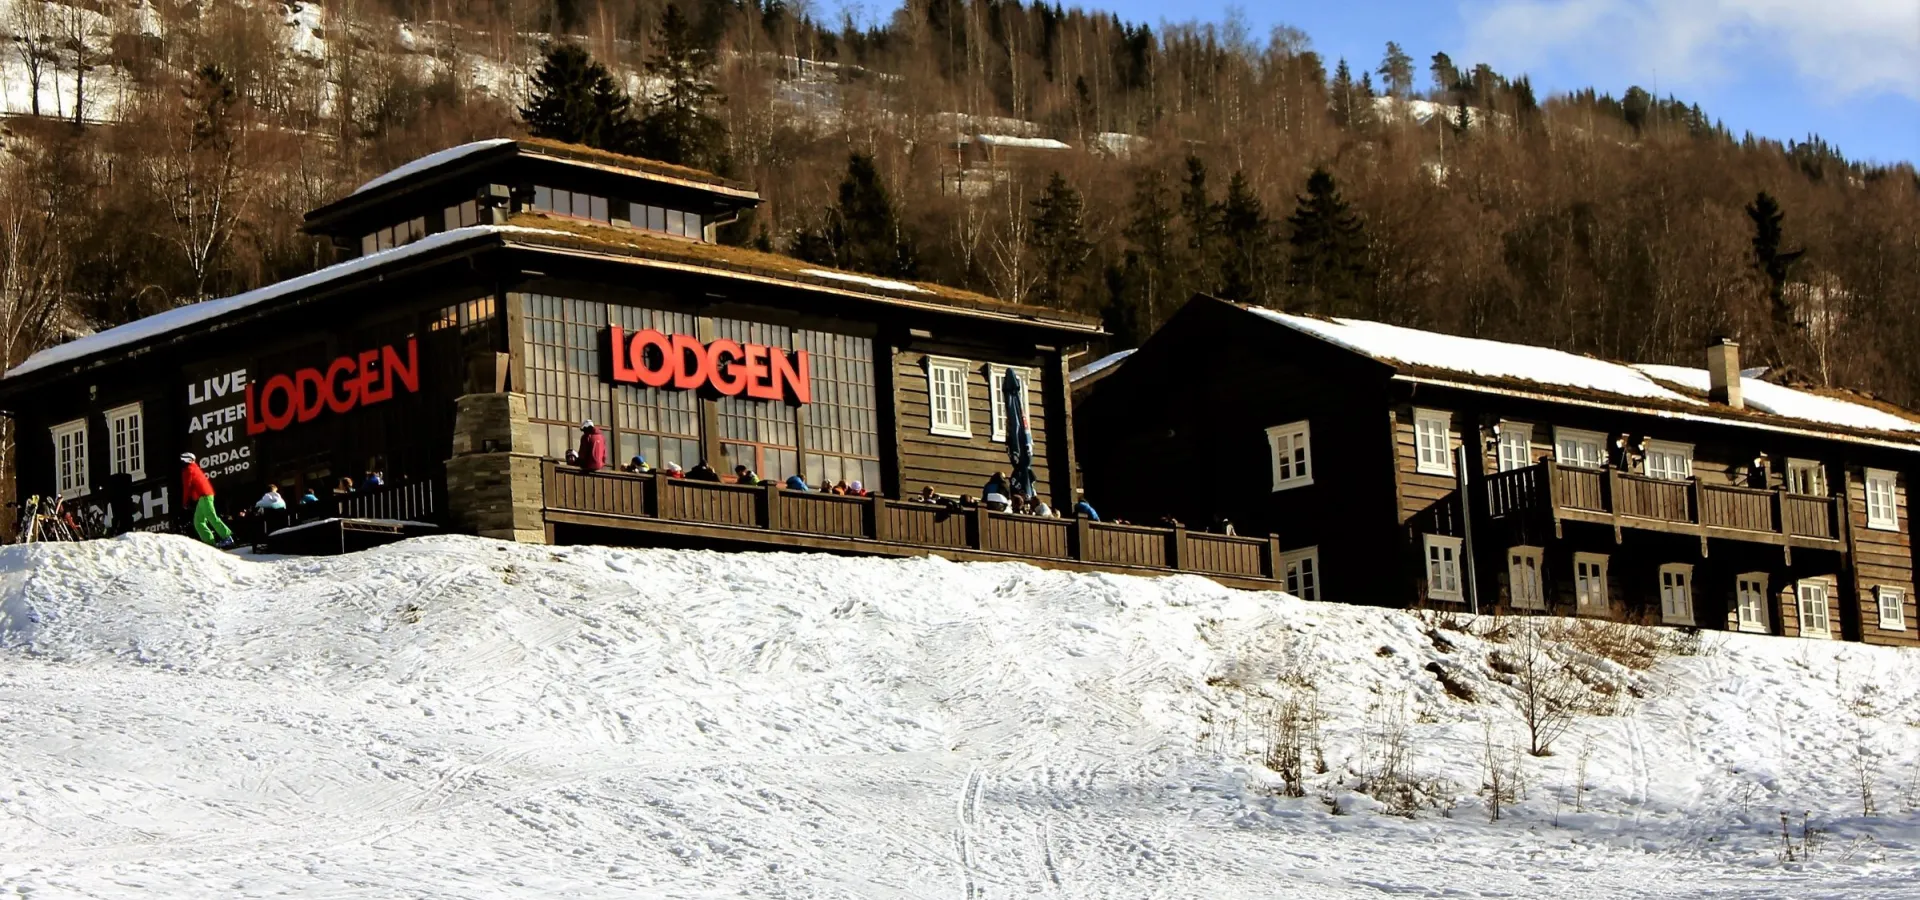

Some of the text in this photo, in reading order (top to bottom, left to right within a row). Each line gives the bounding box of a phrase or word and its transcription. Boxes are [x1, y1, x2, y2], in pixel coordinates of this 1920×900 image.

[611, 325, 811, 404] LODGEN
[188, 368, 247, 406] LIVE
[245, 338, 419, 436] LODGEN
[188, 402, 247, 434] AFTER
[205, 426, 234, 448] SKI
[199, 446, 251, 469] ØRDAG
[224, 461, 250, 475] 1900
